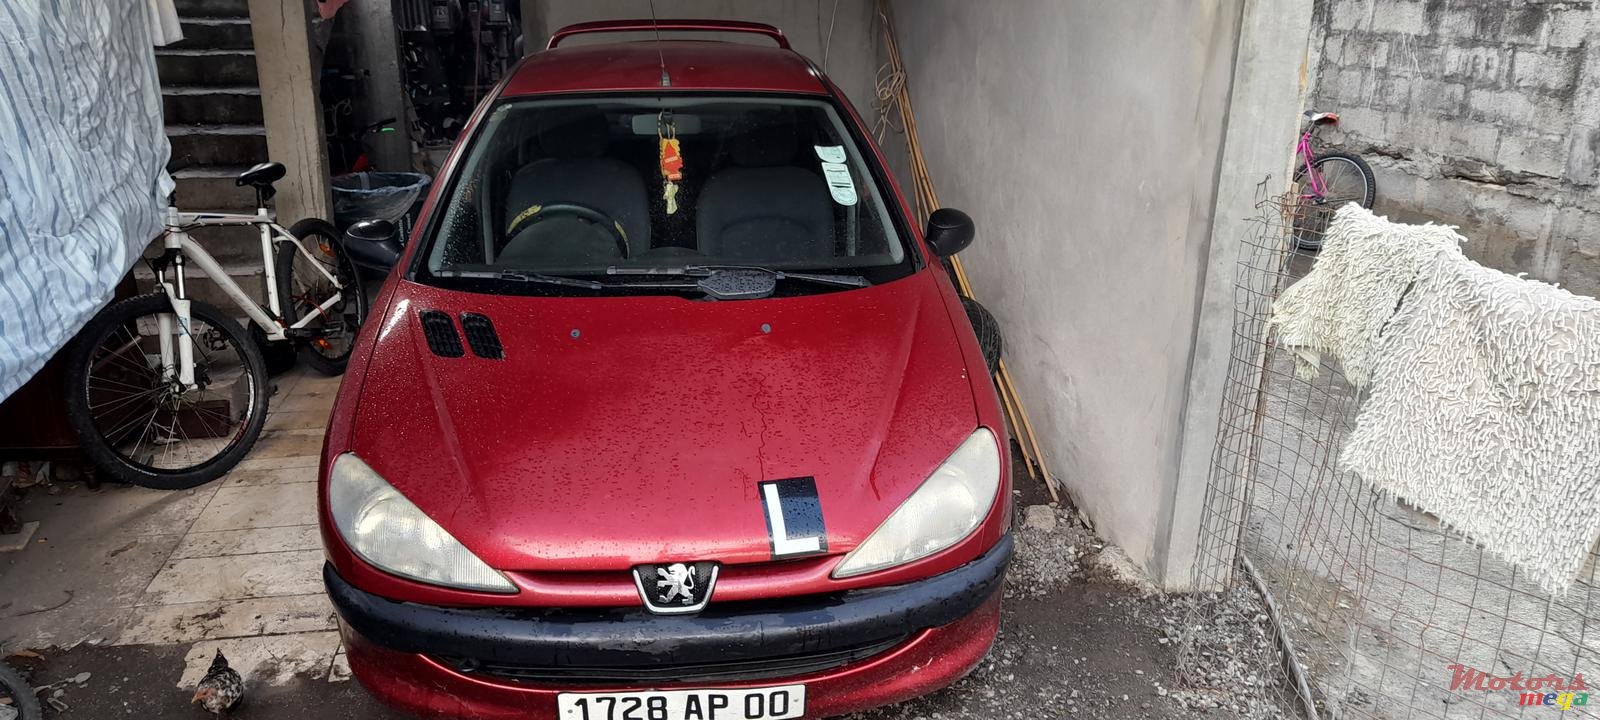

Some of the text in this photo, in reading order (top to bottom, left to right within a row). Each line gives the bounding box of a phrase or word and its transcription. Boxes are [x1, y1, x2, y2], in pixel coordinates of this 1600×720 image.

[763, 484, 820, 555] L
[574, 690, 789, 720] 1728 AP 00
